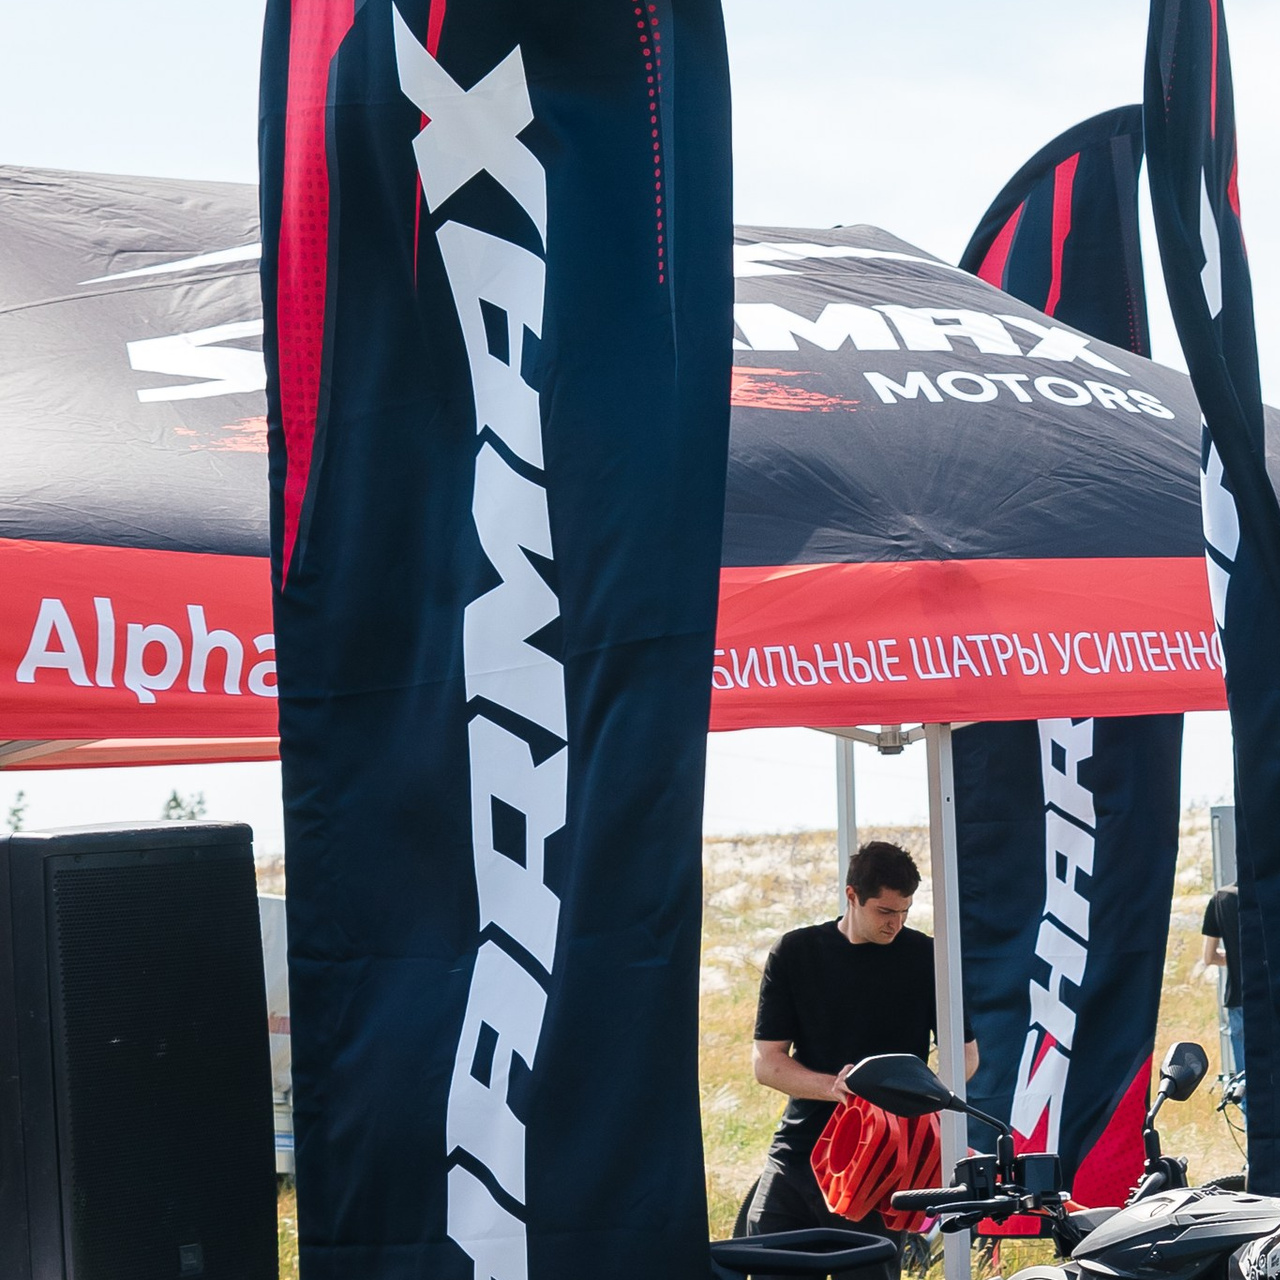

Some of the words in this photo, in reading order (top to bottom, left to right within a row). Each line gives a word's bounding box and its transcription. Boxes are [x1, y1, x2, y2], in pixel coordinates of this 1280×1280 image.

[863, 370, 1176, 420] MOTORS
[16, 597, 279, 704] Alpha
[711, 639, 908, 690] БИЛЬНЫЕ
[908, 632, 1049, 680] ШАТРЫ
[1048, 630, 1225, 675] УСИЛЕНН
[1010, 717, 1096, 1154] SHAR
